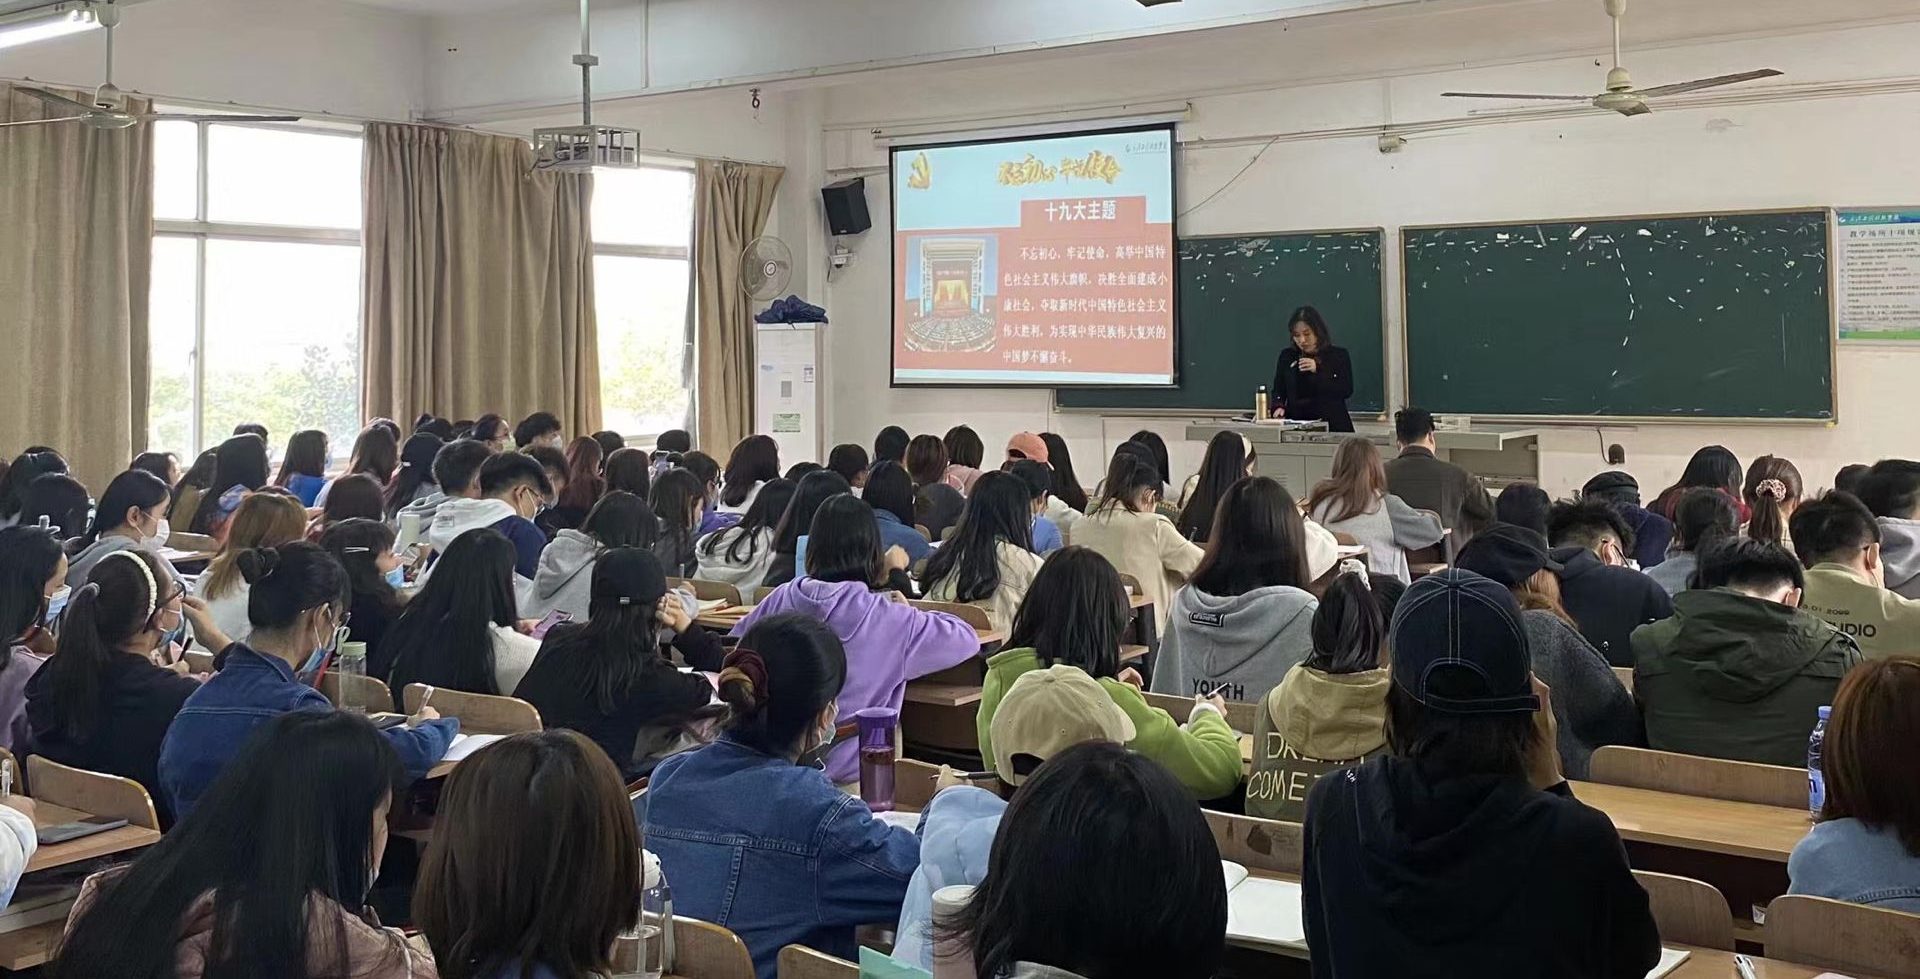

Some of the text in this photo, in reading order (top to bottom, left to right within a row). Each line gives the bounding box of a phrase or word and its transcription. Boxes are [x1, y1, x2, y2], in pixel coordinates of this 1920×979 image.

[1045, 200, 1116, 220] 十九大主题
[1246, 769, 1308, 801] COME
